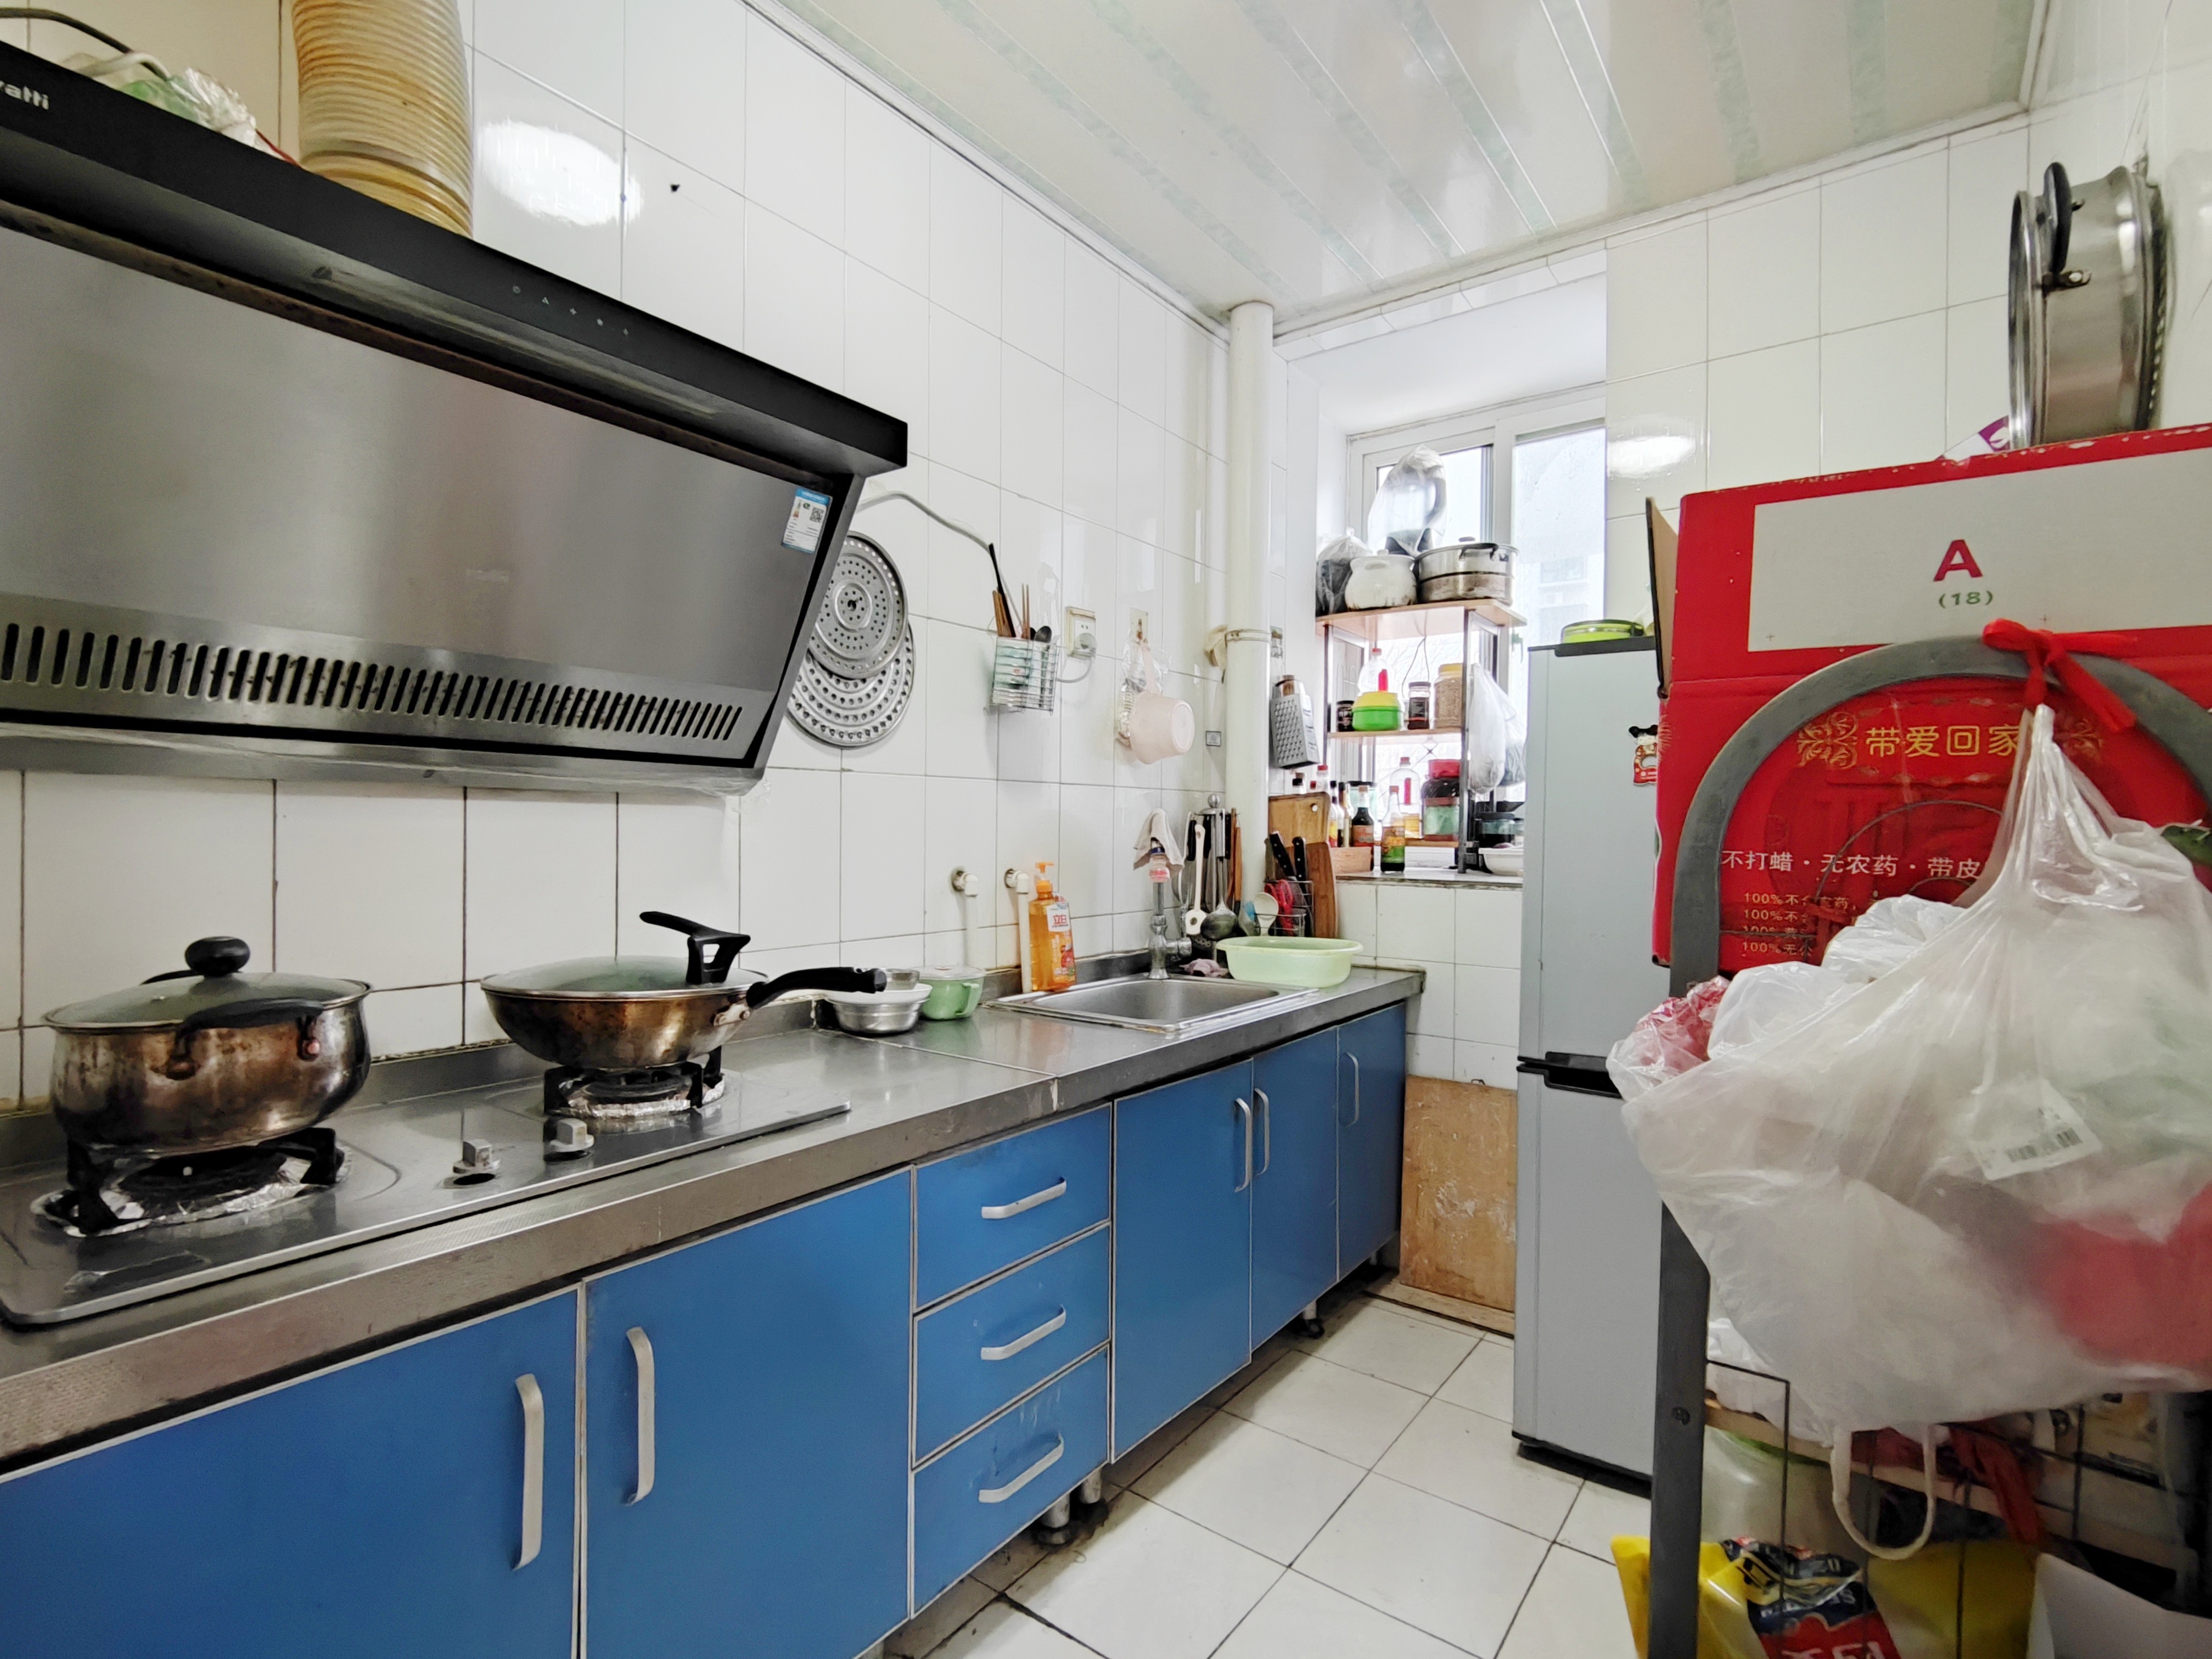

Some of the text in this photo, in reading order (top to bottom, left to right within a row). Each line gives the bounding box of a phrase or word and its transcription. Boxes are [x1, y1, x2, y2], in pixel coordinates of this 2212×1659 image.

[1933, 539, 1983, 582] A
[1939, 590, 1993, 609] (18)
[1866, 724, 2020, 758] 带爱回家
